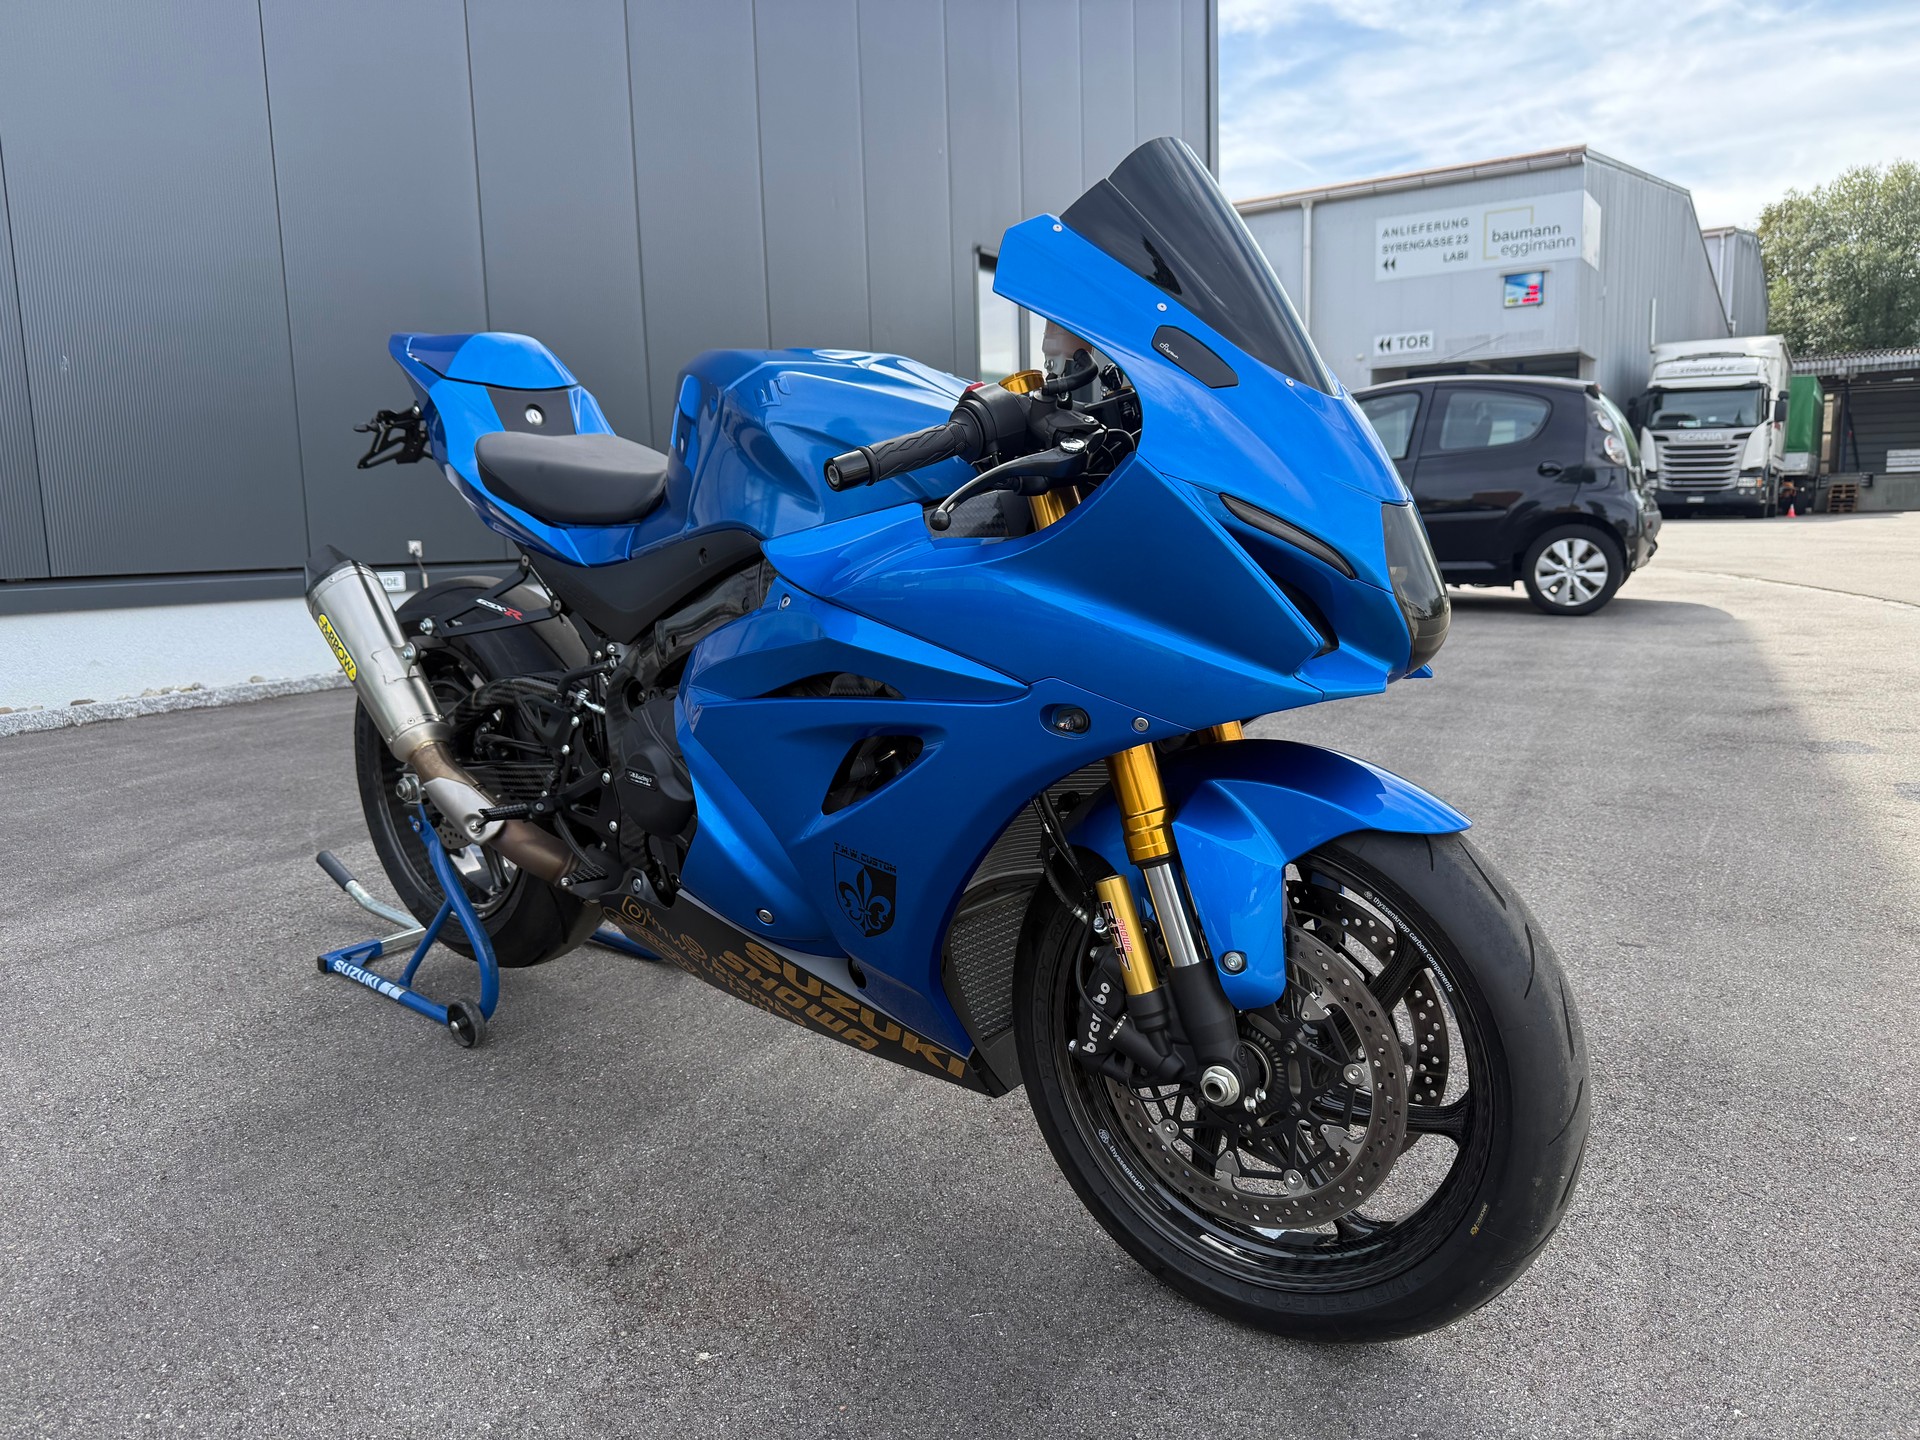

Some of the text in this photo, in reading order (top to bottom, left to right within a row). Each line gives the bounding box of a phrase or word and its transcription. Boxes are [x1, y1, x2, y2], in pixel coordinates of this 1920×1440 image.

[1382, 217, 1469, 239] ANLIEFERUNG
[1492, 224, 1561, 243] baumann
[1382, 234, 1469, 255] SYRENGASSE 23
[1443, 251, 1469, 263] LABI
[1500, 235, 1575, 257] eggimann
[1398, 334, 1429, 349] TOR
[321, 618, 354, 673] ARROW
[1117, 918, 1133, 953] SHOWA
[1373, 896, 1454, 993] thyssenkrupp carbon components
[334, 959, 381, 989] SUZUKI
[719, 950, 879, 1050] SHOWA
[745, 941, 966, 1079] SUZUKI
[1110, 1145, 1146, 1191] thyssenkrupp
